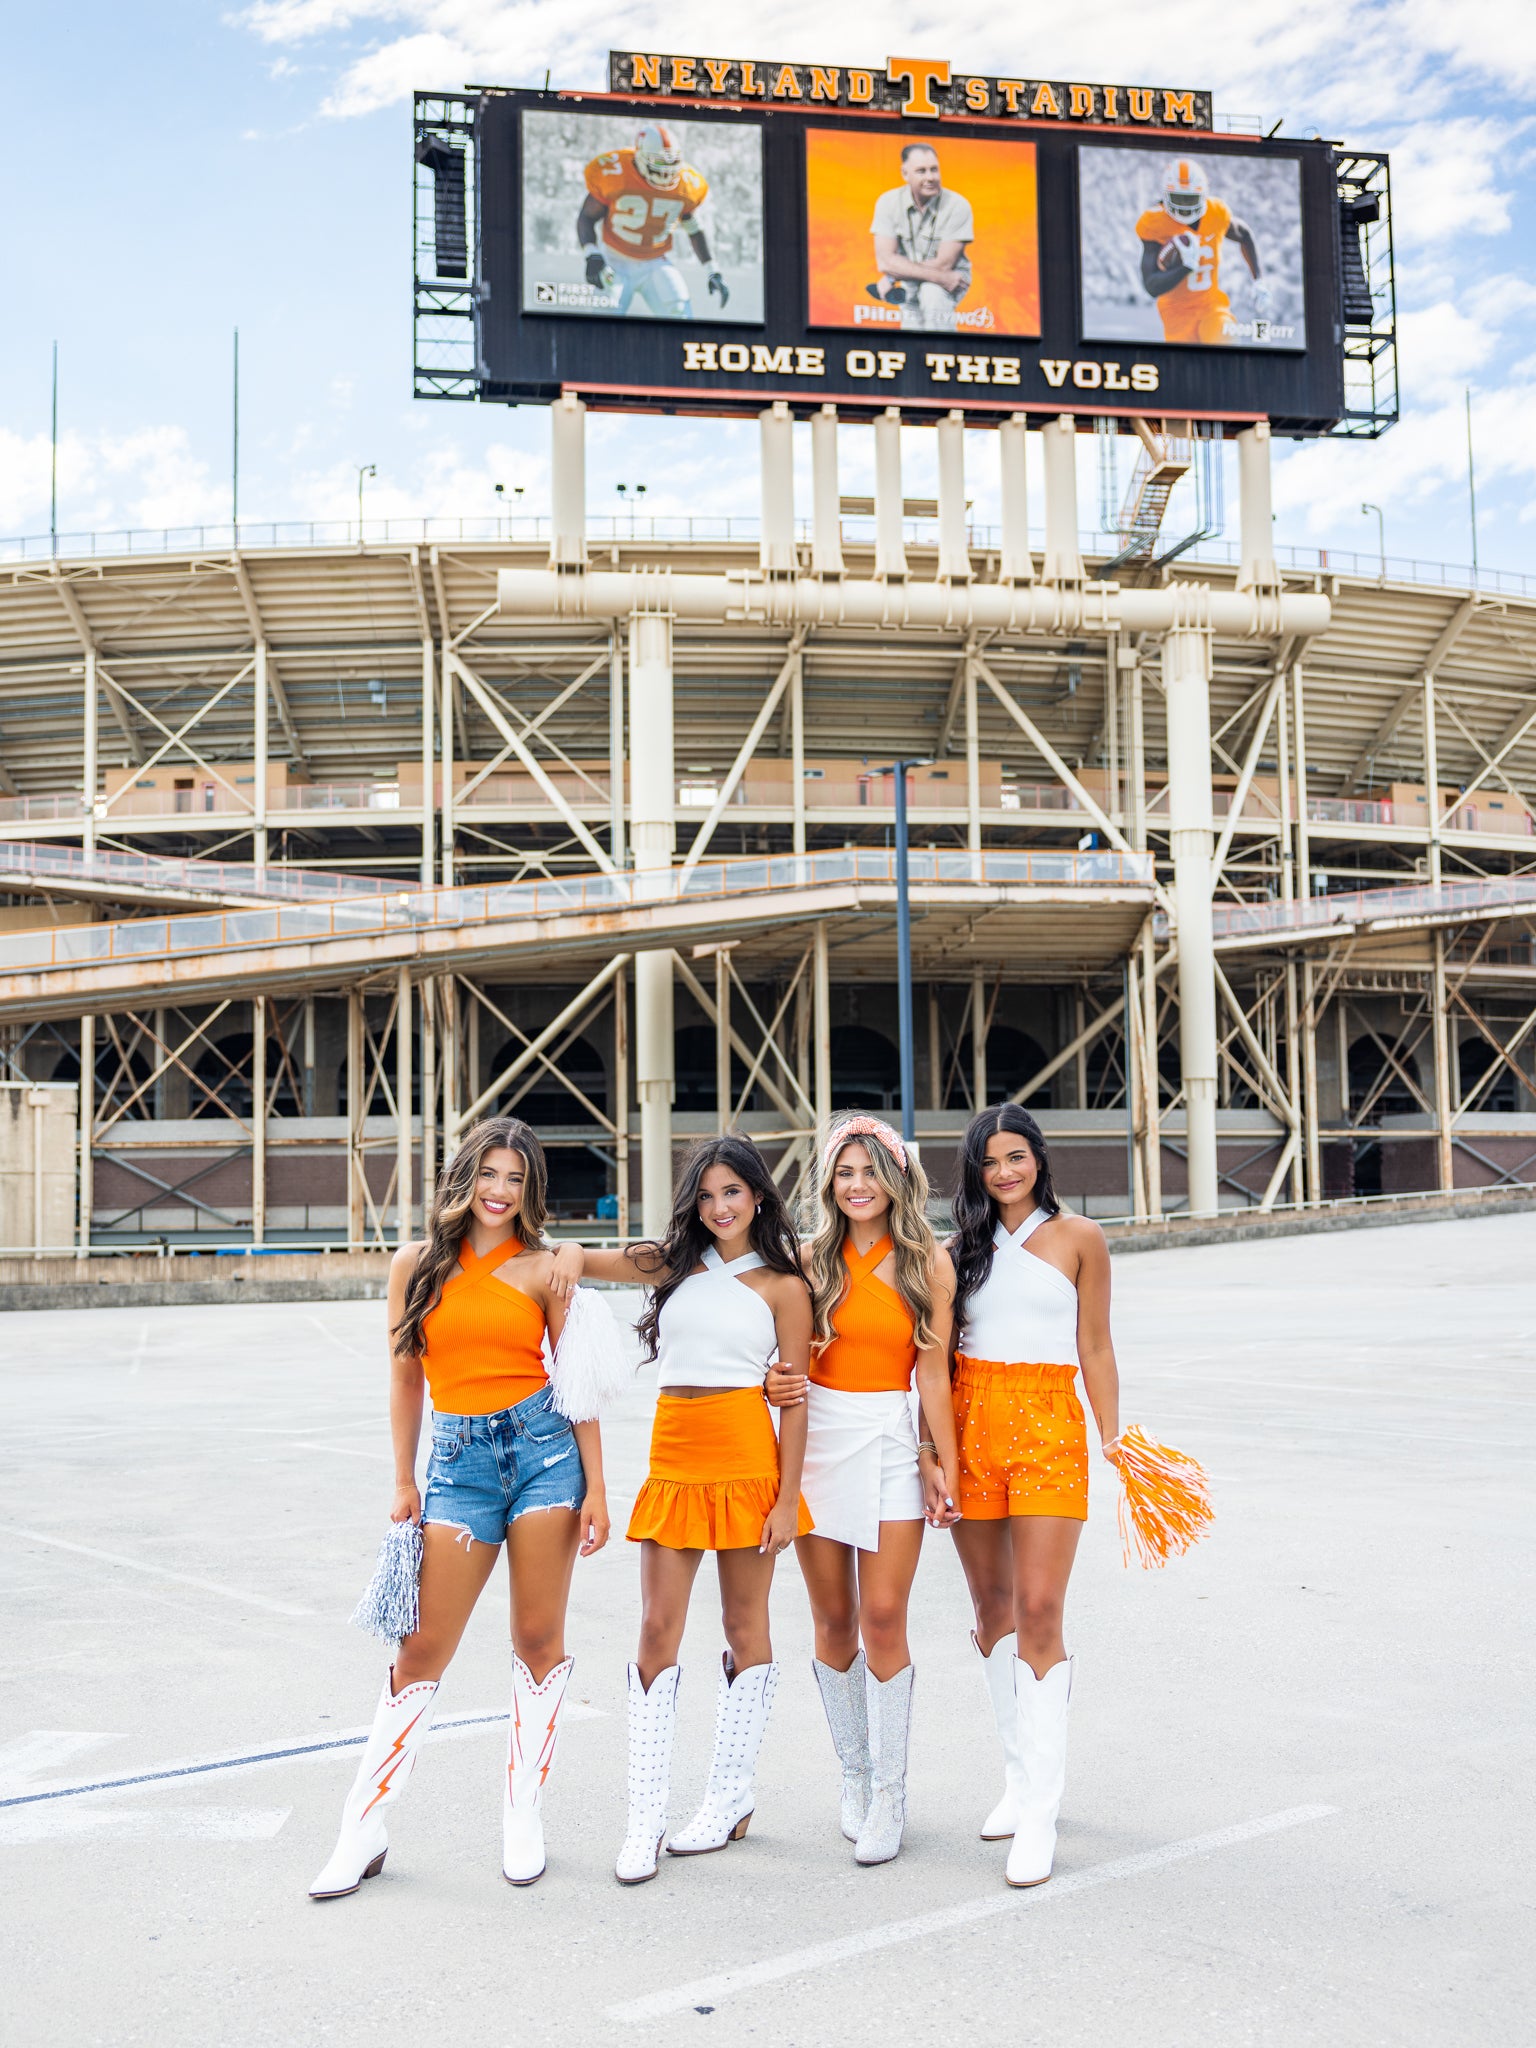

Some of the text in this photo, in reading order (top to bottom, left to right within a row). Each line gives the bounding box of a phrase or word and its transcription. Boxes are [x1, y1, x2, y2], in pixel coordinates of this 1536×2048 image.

[631, 54, 1197, 124] NEYLAND T STADIUM
[611, 194, 685, 246] 27
[558, 283, 596, 296] FIRST
[558, 295, 619, 308] HORIZON
[683, 342, 1160, 392] HOME OF THE VOLS
